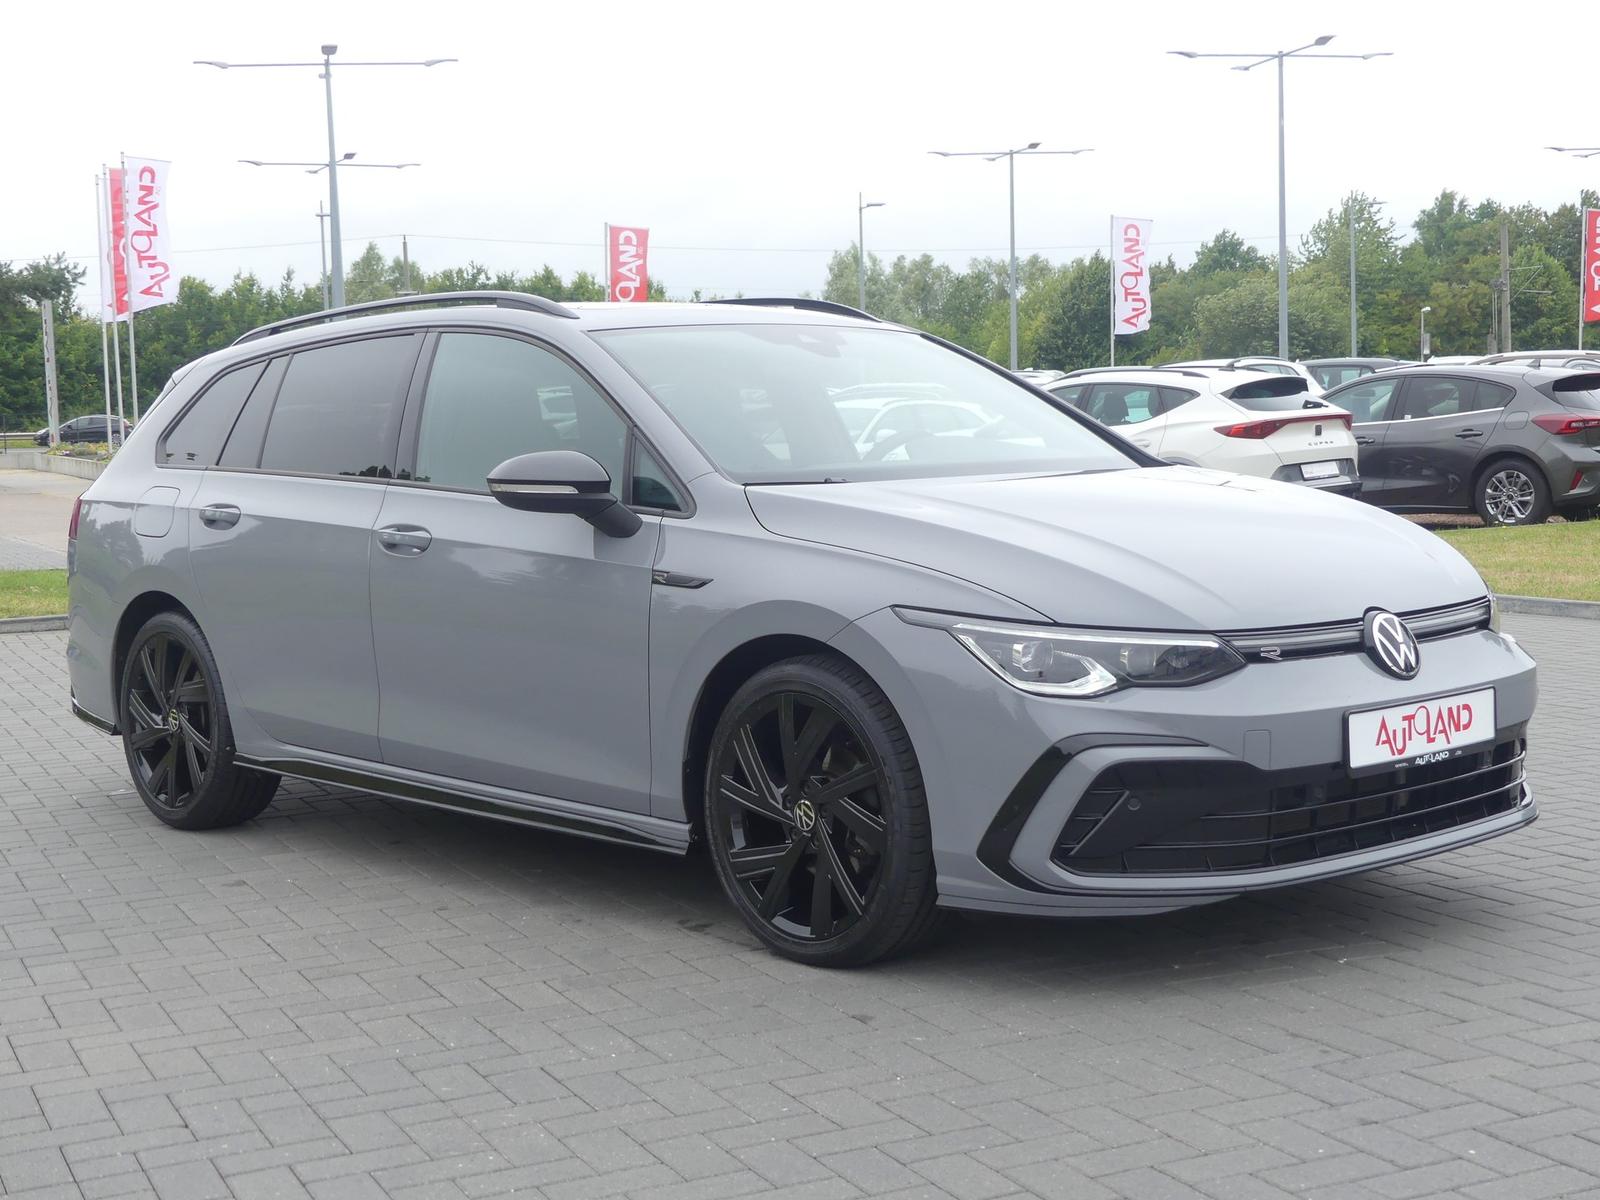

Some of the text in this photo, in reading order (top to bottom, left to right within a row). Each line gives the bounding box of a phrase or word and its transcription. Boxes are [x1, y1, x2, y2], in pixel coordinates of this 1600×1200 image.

[130, 165, 171, 298] AUTOLAND
[1120, 223, 1147, 328] AUTOLAND
[1375, 703, 1473, 756] AUTOLAND
[1414, 751, 1450, 765] AUTOLAND
